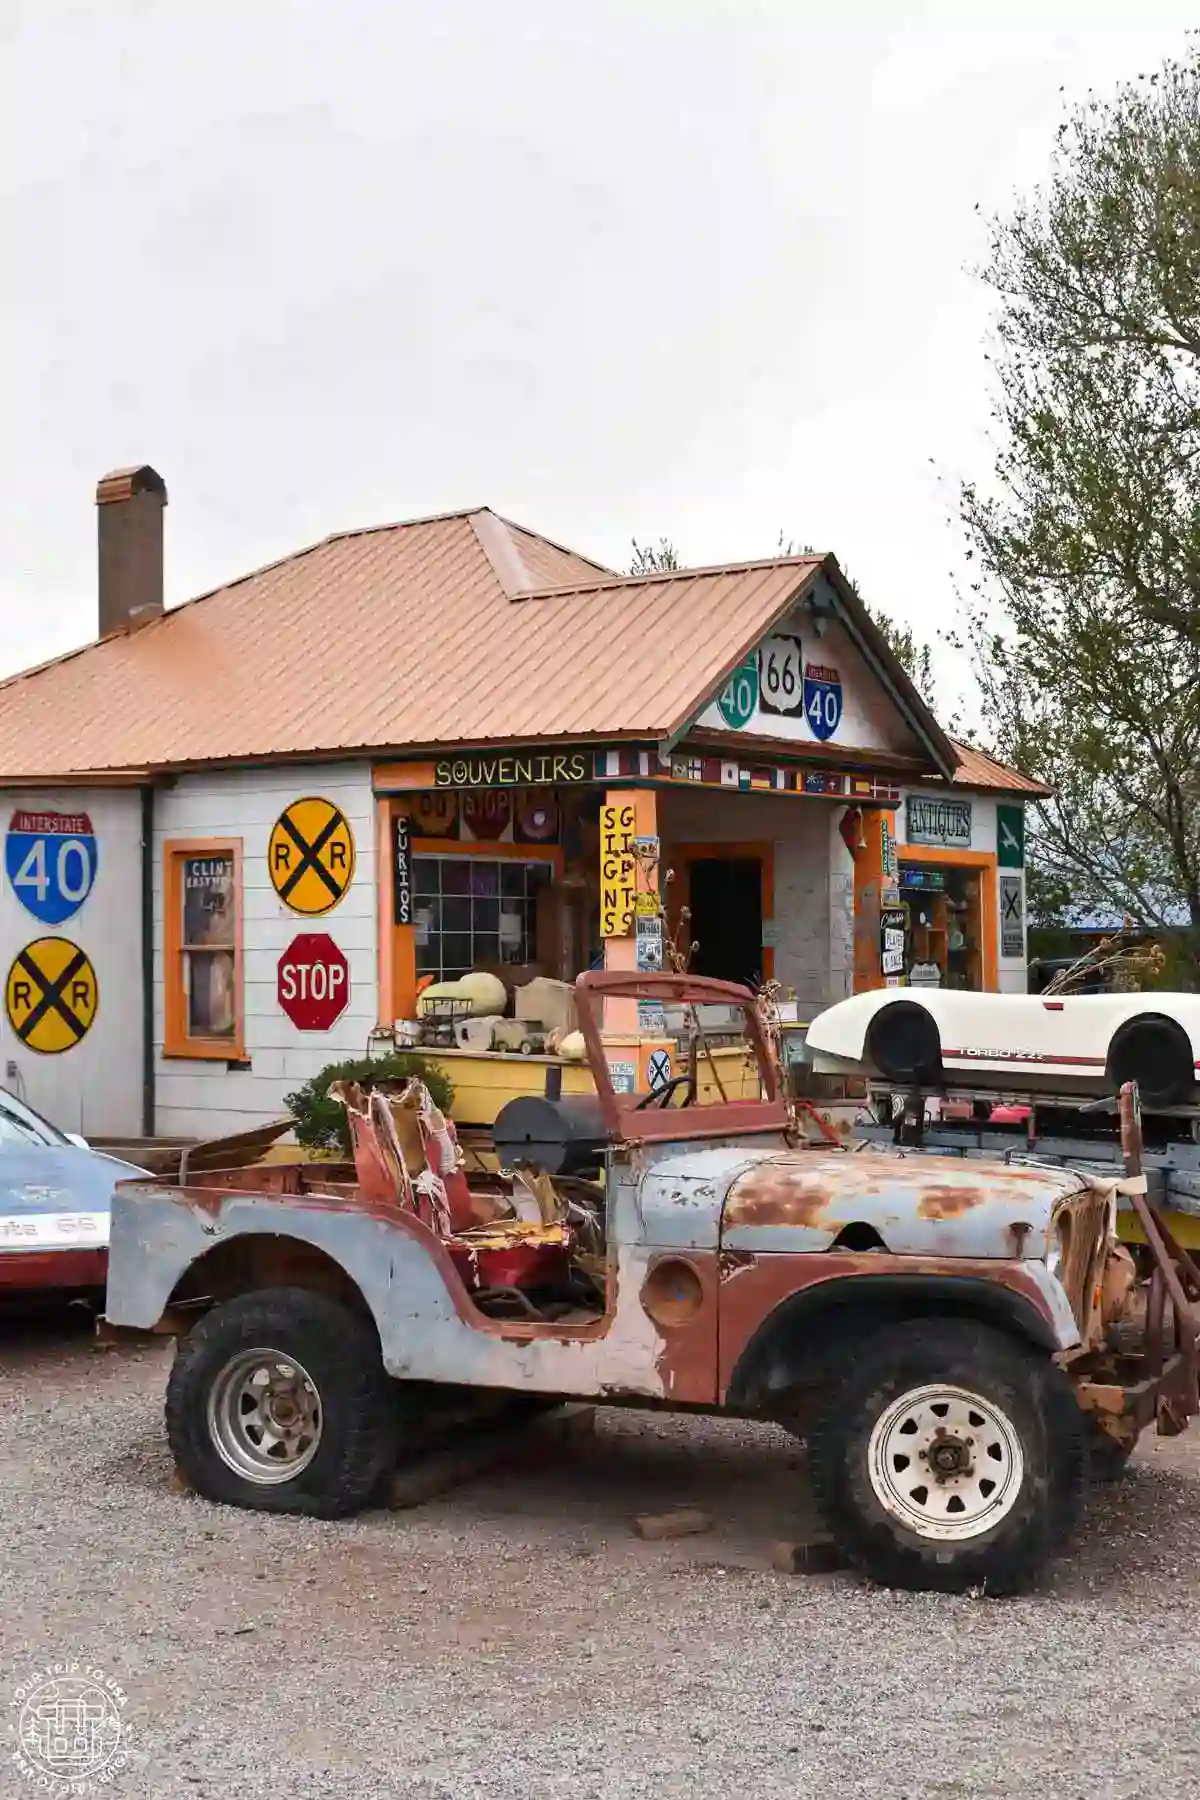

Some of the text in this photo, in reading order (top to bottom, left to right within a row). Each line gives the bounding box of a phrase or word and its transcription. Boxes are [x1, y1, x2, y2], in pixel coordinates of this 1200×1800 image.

[767, 651, 795, 696] 66
[721, 677, 752, 717] 40
[808, 690, 838, 727] 40
[436, 754, 586, 786] SOUVENIRS
[20, 815, 85, 832] INTERSTATE
[911, 801, 970, 841] ANTIQUES
[14, 839, 91, 902] 40
[192, 860, 233, 876] CLINT
[396, 817, 409, 923] CURIOS
[281, 961, 345, 1001] STOP
